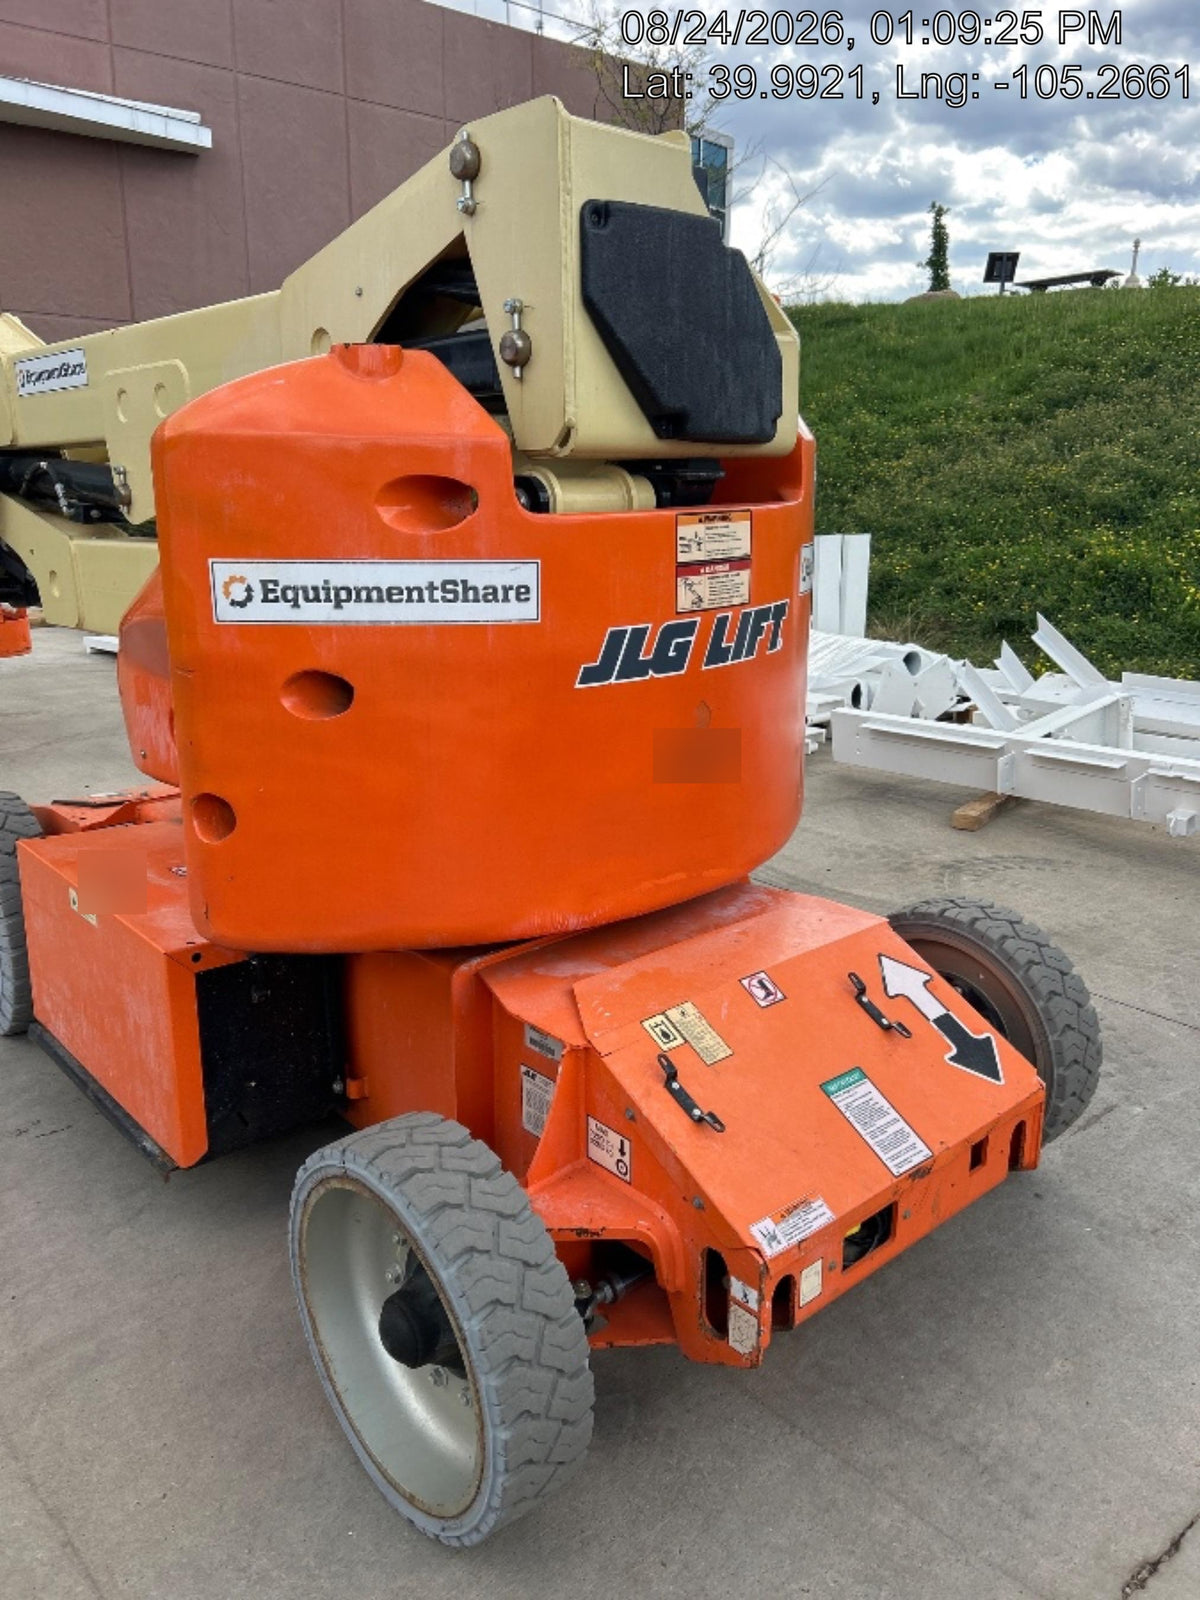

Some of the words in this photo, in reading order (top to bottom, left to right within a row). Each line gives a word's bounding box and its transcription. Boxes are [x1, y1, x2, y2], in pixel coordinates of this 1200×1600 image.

[259, 578, 531, 609] EquipmentShare
[575, 617, 701, 688] JLG
[702, 599, 789, 670] LIFT
